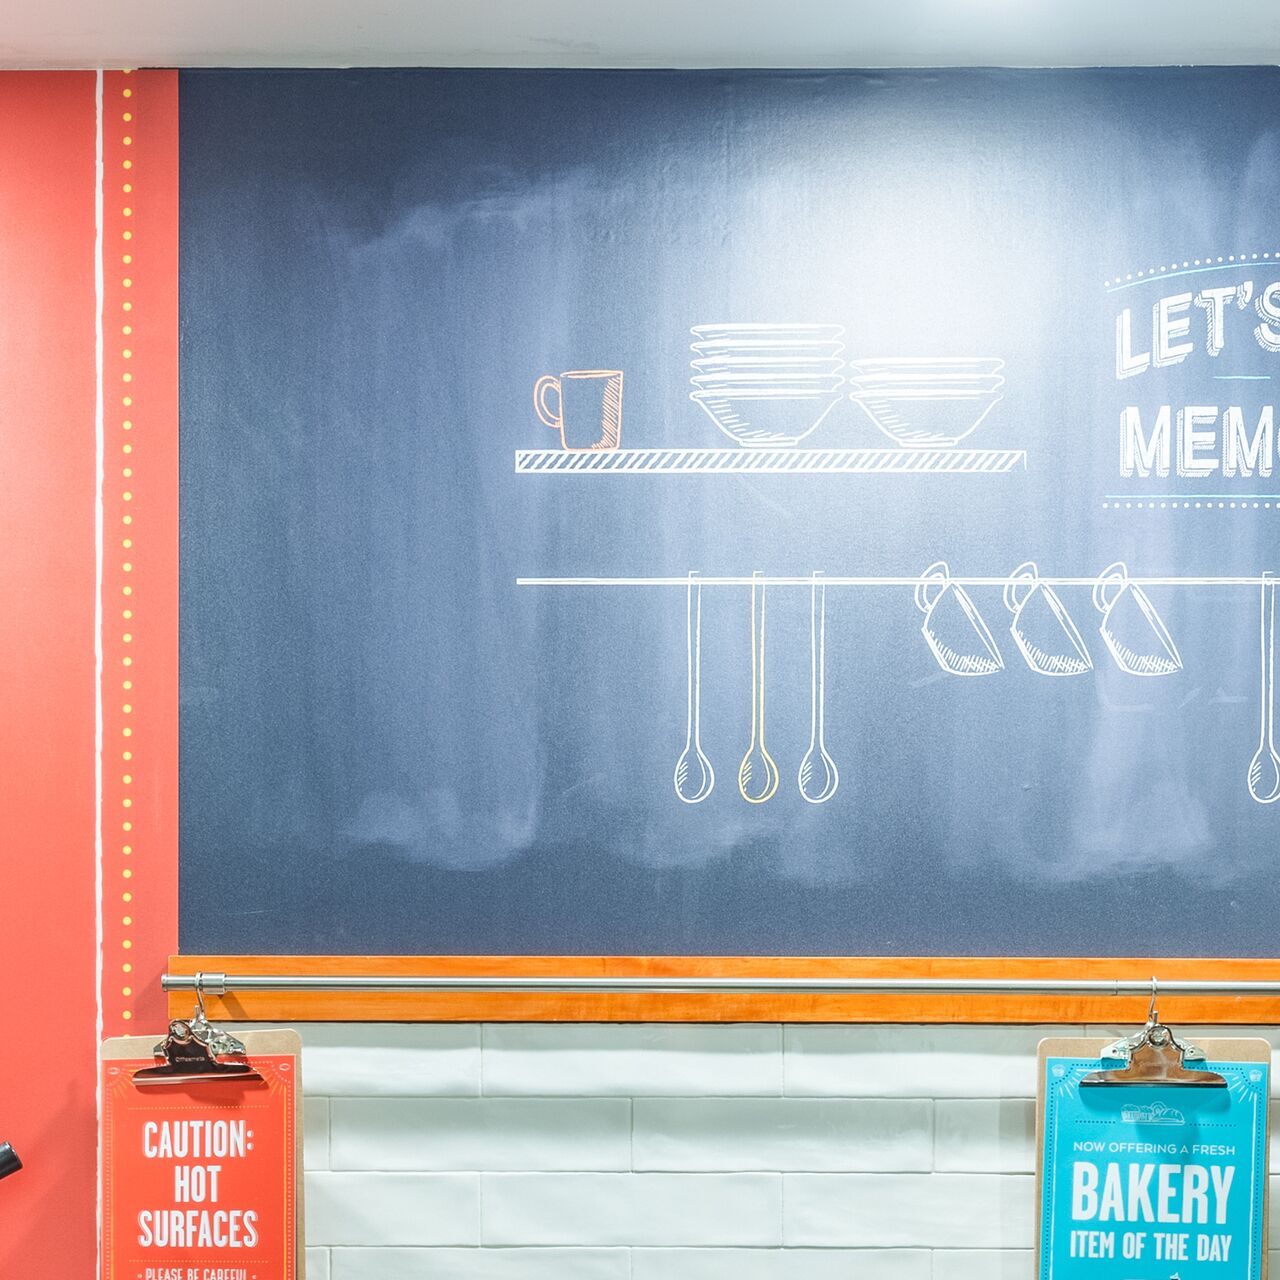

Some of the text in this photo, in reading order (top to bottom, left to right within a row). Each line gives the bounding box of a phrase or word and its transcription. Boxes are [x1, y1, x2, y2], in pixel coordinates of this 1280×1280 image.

[143, 1119, 255, 1158] CAUTION:
[1073, 1141, 1236, 1156] NOW OFFERING A FRESH
[174, 1165, 221, 1203] HOT
[1072, 1161, 1236, 1225] BAKERY
[137, 1210, 258, 1248] SURFACES
[1070, 1230, 1233, 1263] ITEM OF THE DAY
